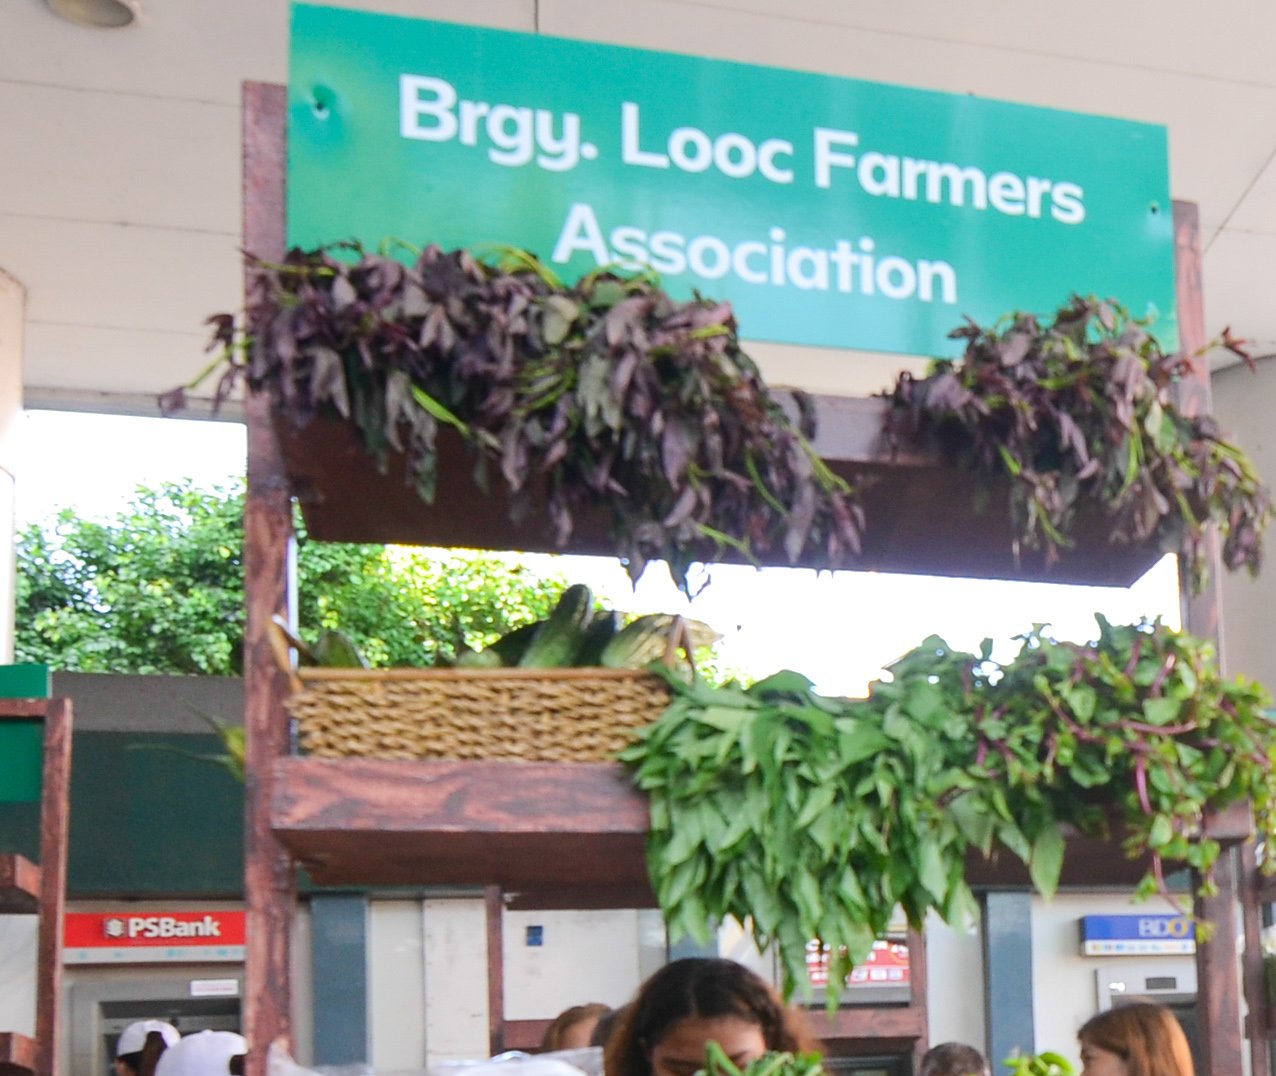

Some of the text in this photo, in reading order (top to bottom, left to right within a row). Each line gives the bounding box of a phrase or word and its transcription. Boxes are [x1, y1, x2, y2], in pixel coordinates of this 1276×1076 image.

[400, 74, 1086, 225] Brgy. Looc Farmers
[552, 203, 957, 304] Association
[128, 915, 221, 938] PSBank
[1138, 918, 1189, 938] BDO
